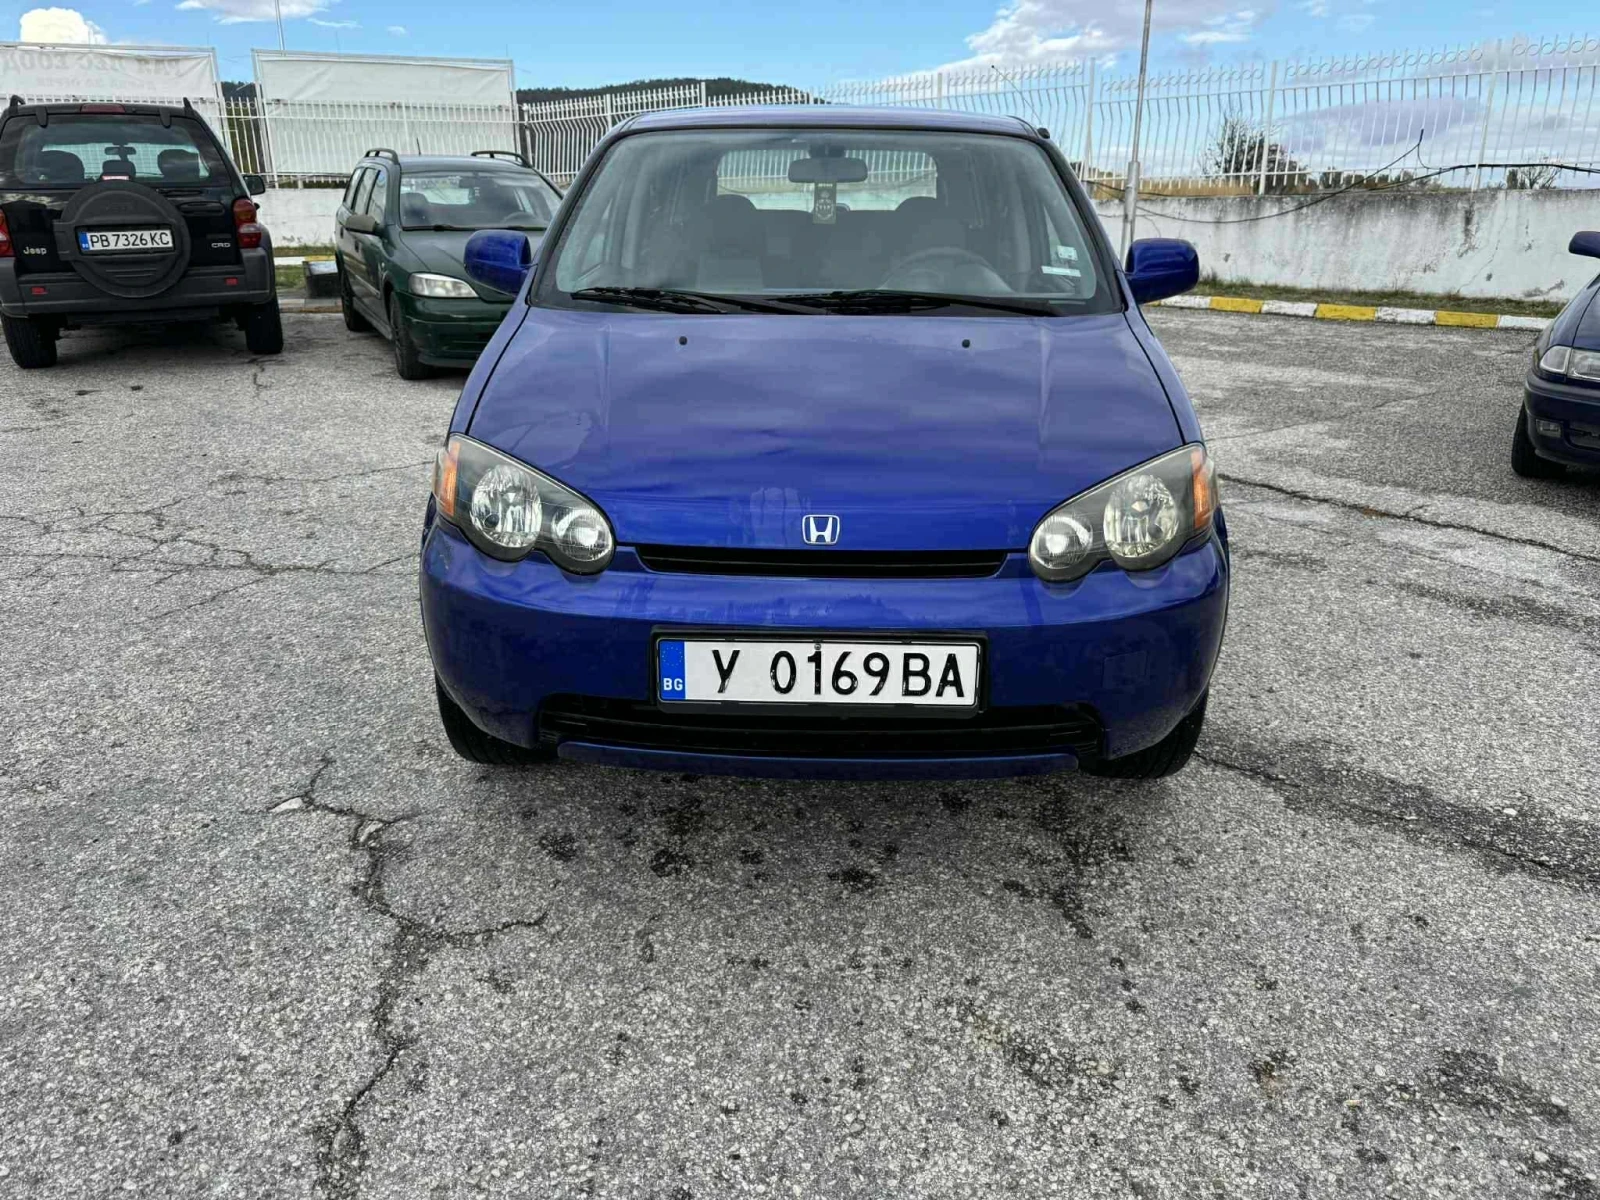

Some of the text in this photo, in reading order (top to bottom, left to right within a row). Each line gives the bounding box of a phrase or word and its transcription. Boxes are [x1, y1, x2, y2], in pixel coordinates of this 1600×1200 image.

[112, 232, 148, 247] 7326
[23, 246, 47, 255] Jeep
[663, 677, 683, 691] BG
